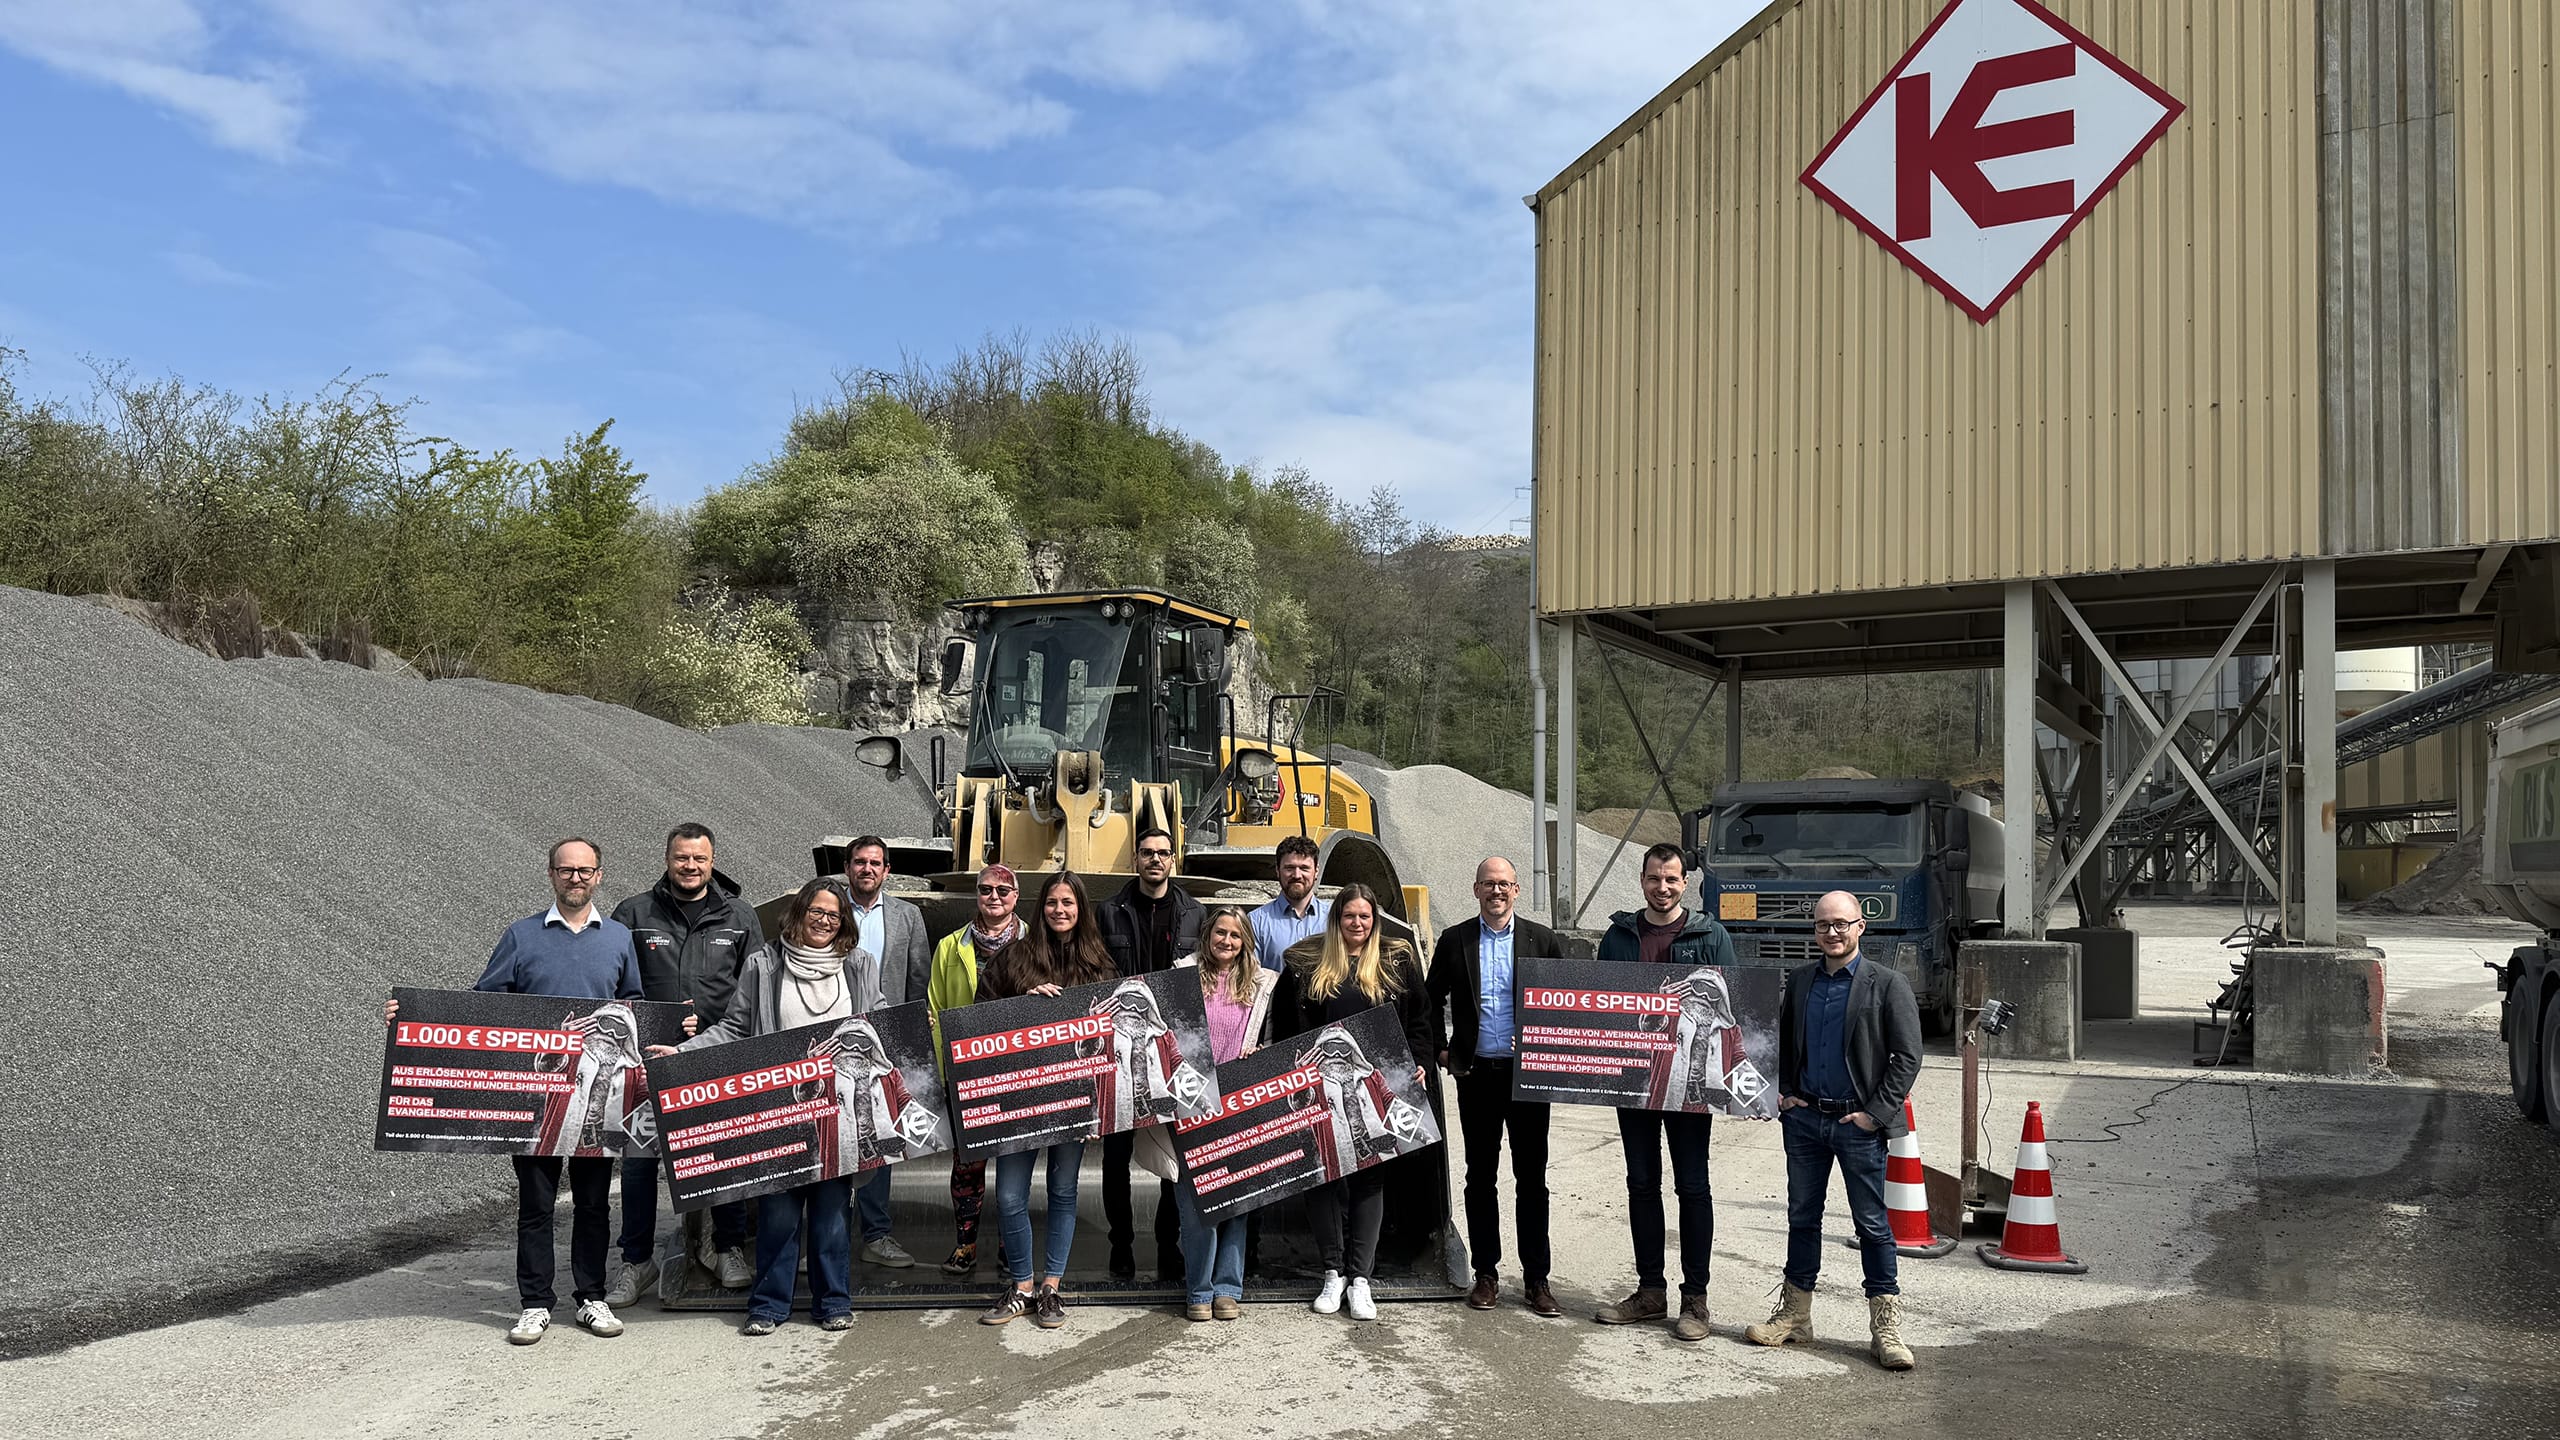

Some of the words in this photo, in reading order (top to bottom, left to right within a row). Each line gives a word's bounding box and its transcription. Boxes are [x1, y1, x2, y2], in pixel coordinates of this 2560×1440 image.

[1896, 43, 2075, 243] KE
[1866, 901, 1877, 914] L
[1525, 991, 1575, 1008] 1.000
[1580, 994, 1591, 1009] €
[1596, 994, 1680, 1013] SPENDE
[399, 1026, 461, 1045] 1.000
[467, 1029, 480, 1046] €
[486, 1030, 583, 1051] SPENDE
[953, 1036, 1007, 1060] 1.000
[1011, 1033, 1024, 1050] €
[1028, 1017, 1112, 1046] SPENDE
[1523, 1027, 1540, 1035] AUS
[1542, 1027, 1580, 1037] ERLÖSEN
[1582, 1029, 1599, 1037] VON
[1533, 1036, 1587, 1046] STEINBRUCH
[1588, 1039, 1651, 1049] MUNDELSHEIM
[1522, 1052, 1538, 1061] FÜR
[1540, 1053, 1556, 1062] DEN
[1559, 1054, 1650, 1067] WALDKINDERGARTEN
[391, 1077, 403, 1086] IM
[406, 1078, 471, 1088] STEINBRUCH
[474, 1080, 547, 1091] MUNDELSHEIM
[392, 1067, 413, 1076] AUS
[416, 1067, 463, 1078] ERLÖSEN
[466, 1070, 487, 1079] VON
[661, 1083, 719, 1110] 1.000
[723, 1079, 737, 1097] €
[742, 1058, 833, 1093] SPENDE
[958, 1080, 976, 1091] AUS
[978, 1071, 1019, 1087] ERLÖSEN
[1020, 1068, 1039, 1079] VON
[959, 1091, 969, 1100] IM
[972, 1080, 1028, 1098] STEINBRUCH
[1030, 1068, 1092, 1087] MUNDELSHEIM
[1175, 1073, 1198, 1098] KE
[389, 1096, 411, 1105] FÜR
[413, 1098, 433, 1106] DAS
[1227, 1095, 1240, 1113] €
[1243, 1066, 1322, 1107] SPENDE
[388, 1108, 466, 1118] EVANGELISCHE
[469, 1111, 534, 1121] KINDERHAUS
[962, 1107, 980, 1119] FÜR
[982, 1104, 1000, 1115] DEN
[963, 1107, 1033, 1128] KINDERGARTEN
[1035, 1096, 1090, 1114] WIRBELWIND
[1391, 1109, 1416, 1134] KE
[668, 1130, 687, 1141] AUS
[689, 1118, 733, 1137] ERLÖSEN
[734, 1114, 754, 1126] VON
[669, 1141, 680, 1151] IM
[682, 1127, 742, 1148] STEINBRUCH
[745, 1111, 812, 1134] MUNDELSHEIM
[904, 1112, 928, 1138] KE
[1184, 1148, 1201, 1160] AUS
[1203, 1133, 1240, 1153] ERLÖSEN
[1241, 1127, 1259, 1140] VON
[1188, 1160, 1197, 1169] IM
[1199, 1141, 1250, 1165] STEINBRUCH
[1251, 1120, 1309, 1147] MUNDELSHEIM
[673, 1157, 692, 1169] FÜR
[695, 1153, 714, 1165] DEN
[675, 1155, 749, 1180] KINDERGARTEN
[752, 1142, 807, 1162] SEELHOFEN
[1196, 1166, 1259, 1196] KINDERGARTEN
[1261, 1149, 1304, 1172] DAMMWEG
[1193, 1171, 1211, 1185] FÜR
[1212, 1166, 1228, 1178] DEN
